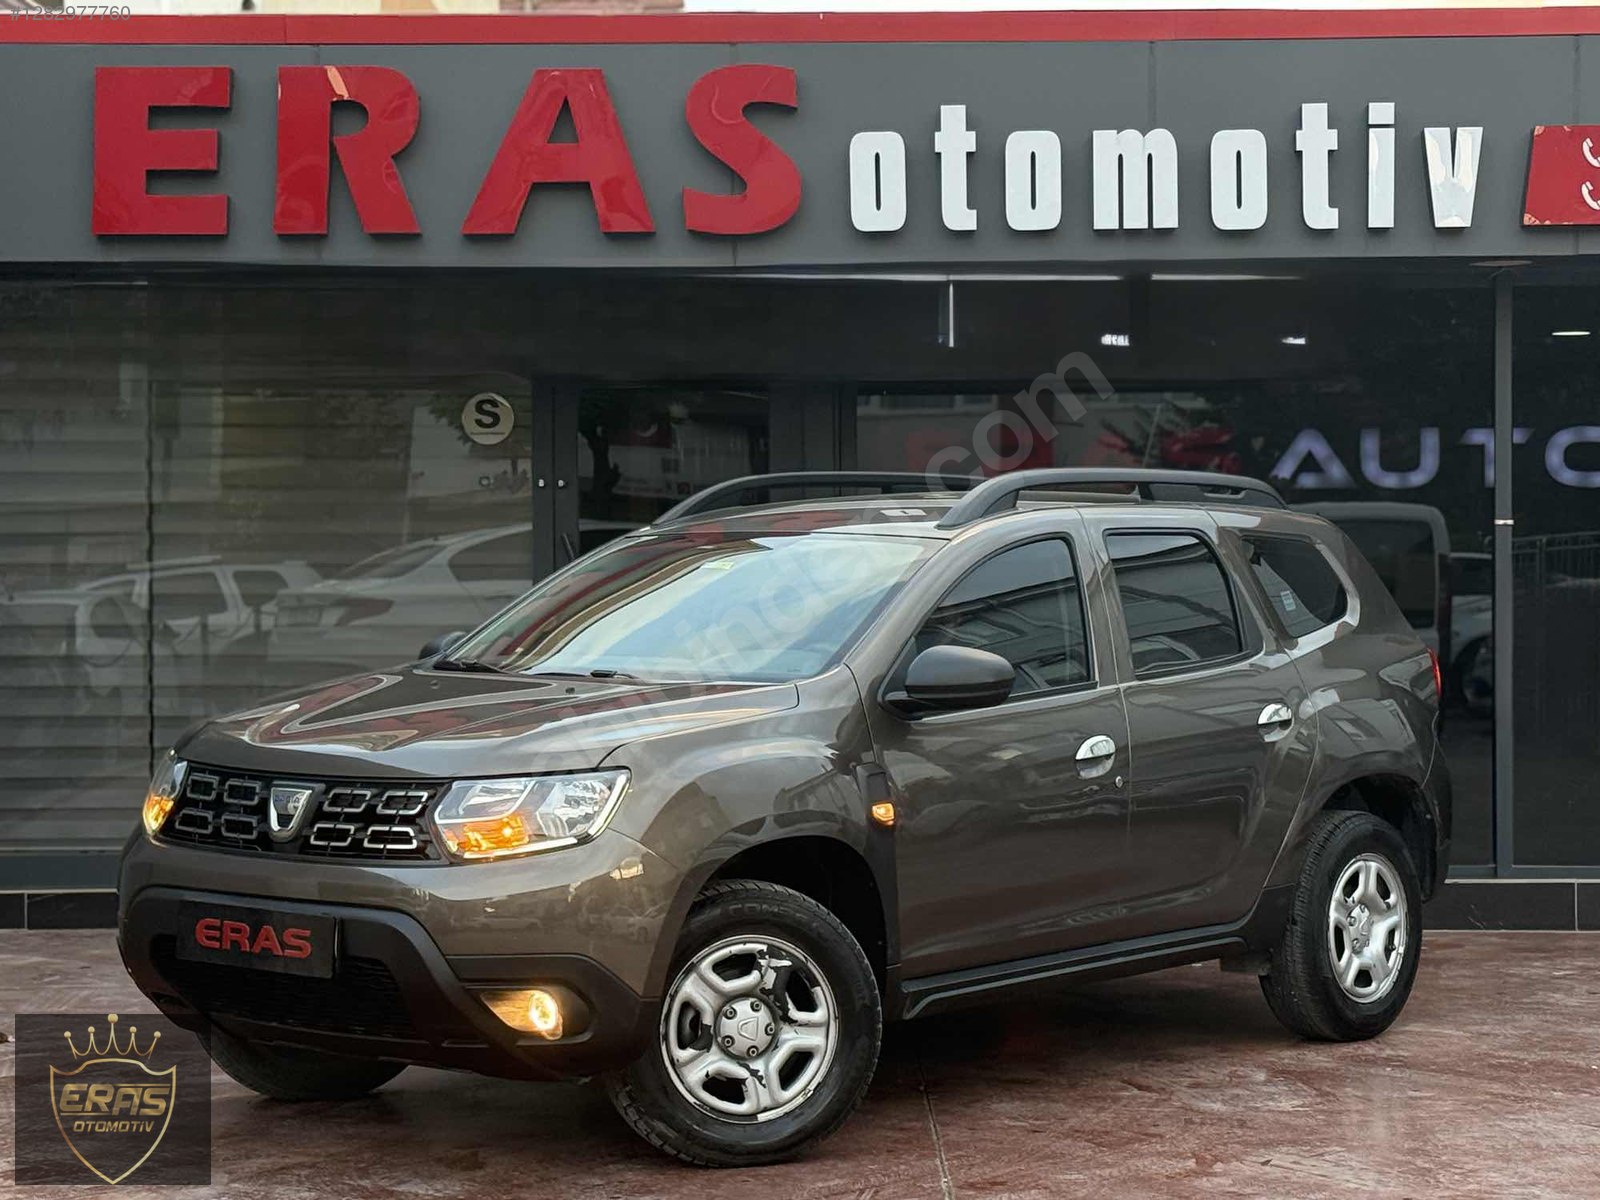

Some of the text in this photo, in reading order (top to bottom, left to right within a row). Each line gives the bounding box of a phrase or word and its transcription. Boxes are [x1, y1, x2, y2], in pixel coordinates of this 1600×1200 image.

[93, 64, 1484, 235] ERAS otomotiv
[474, 398, 501, 429] S
[195, 918, 312, 958] ERAS
